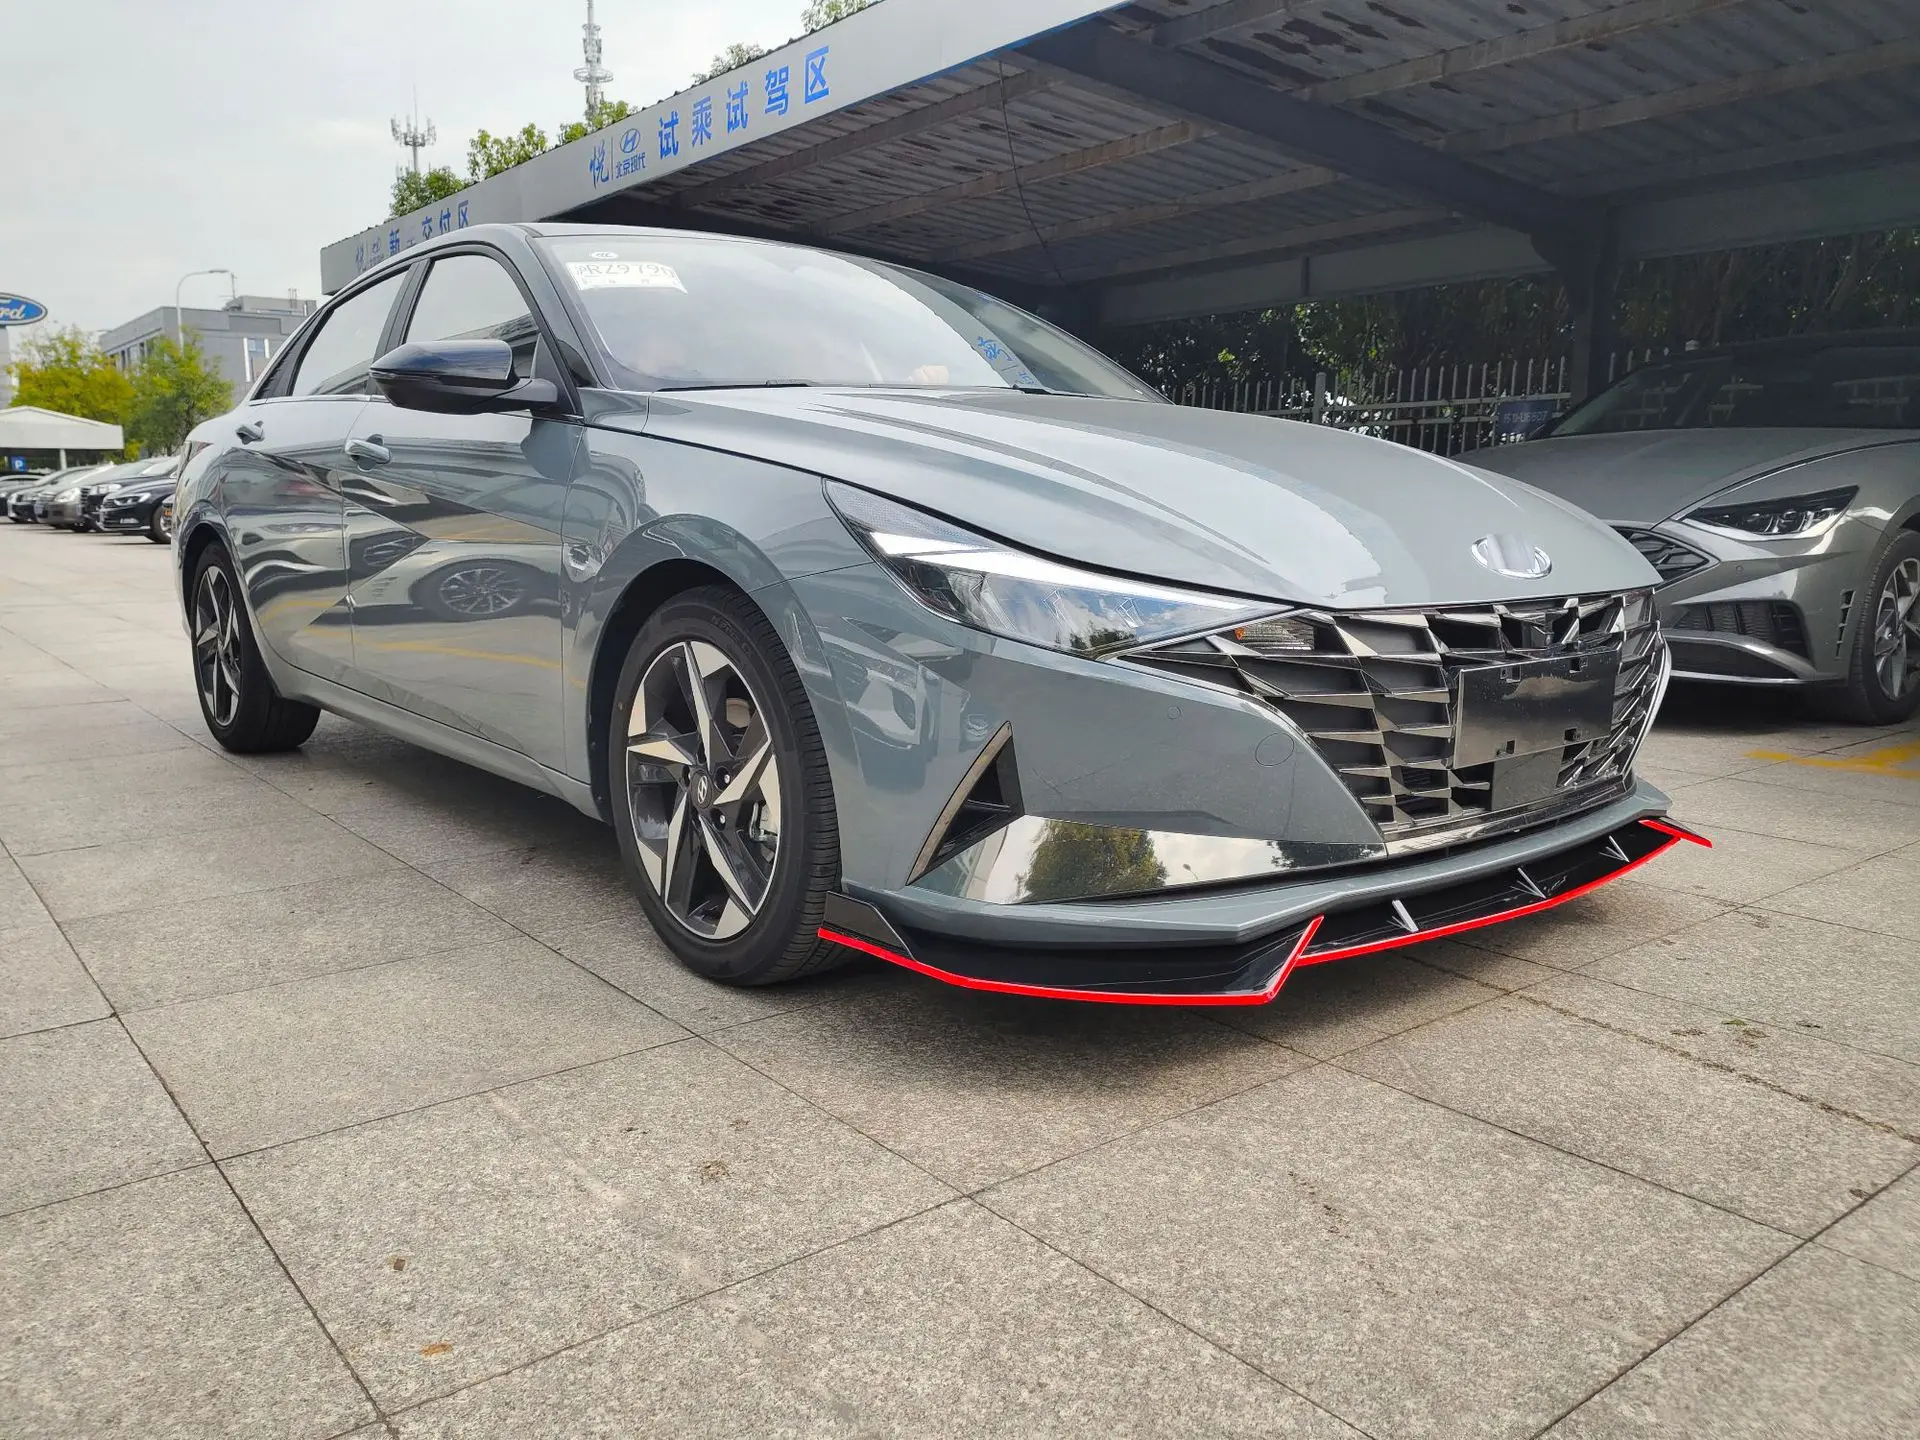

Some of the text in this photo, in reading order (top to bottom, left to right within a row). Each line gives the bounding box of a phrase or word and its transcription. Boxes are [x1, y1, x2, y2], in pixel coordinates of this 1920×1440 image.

[658, 45, 830, 160] 试乘试驾区
[589, 139, 609, 189] 悦
[615, 151, 646, 179] 北京现代
[14, 460, 24, 469] P
